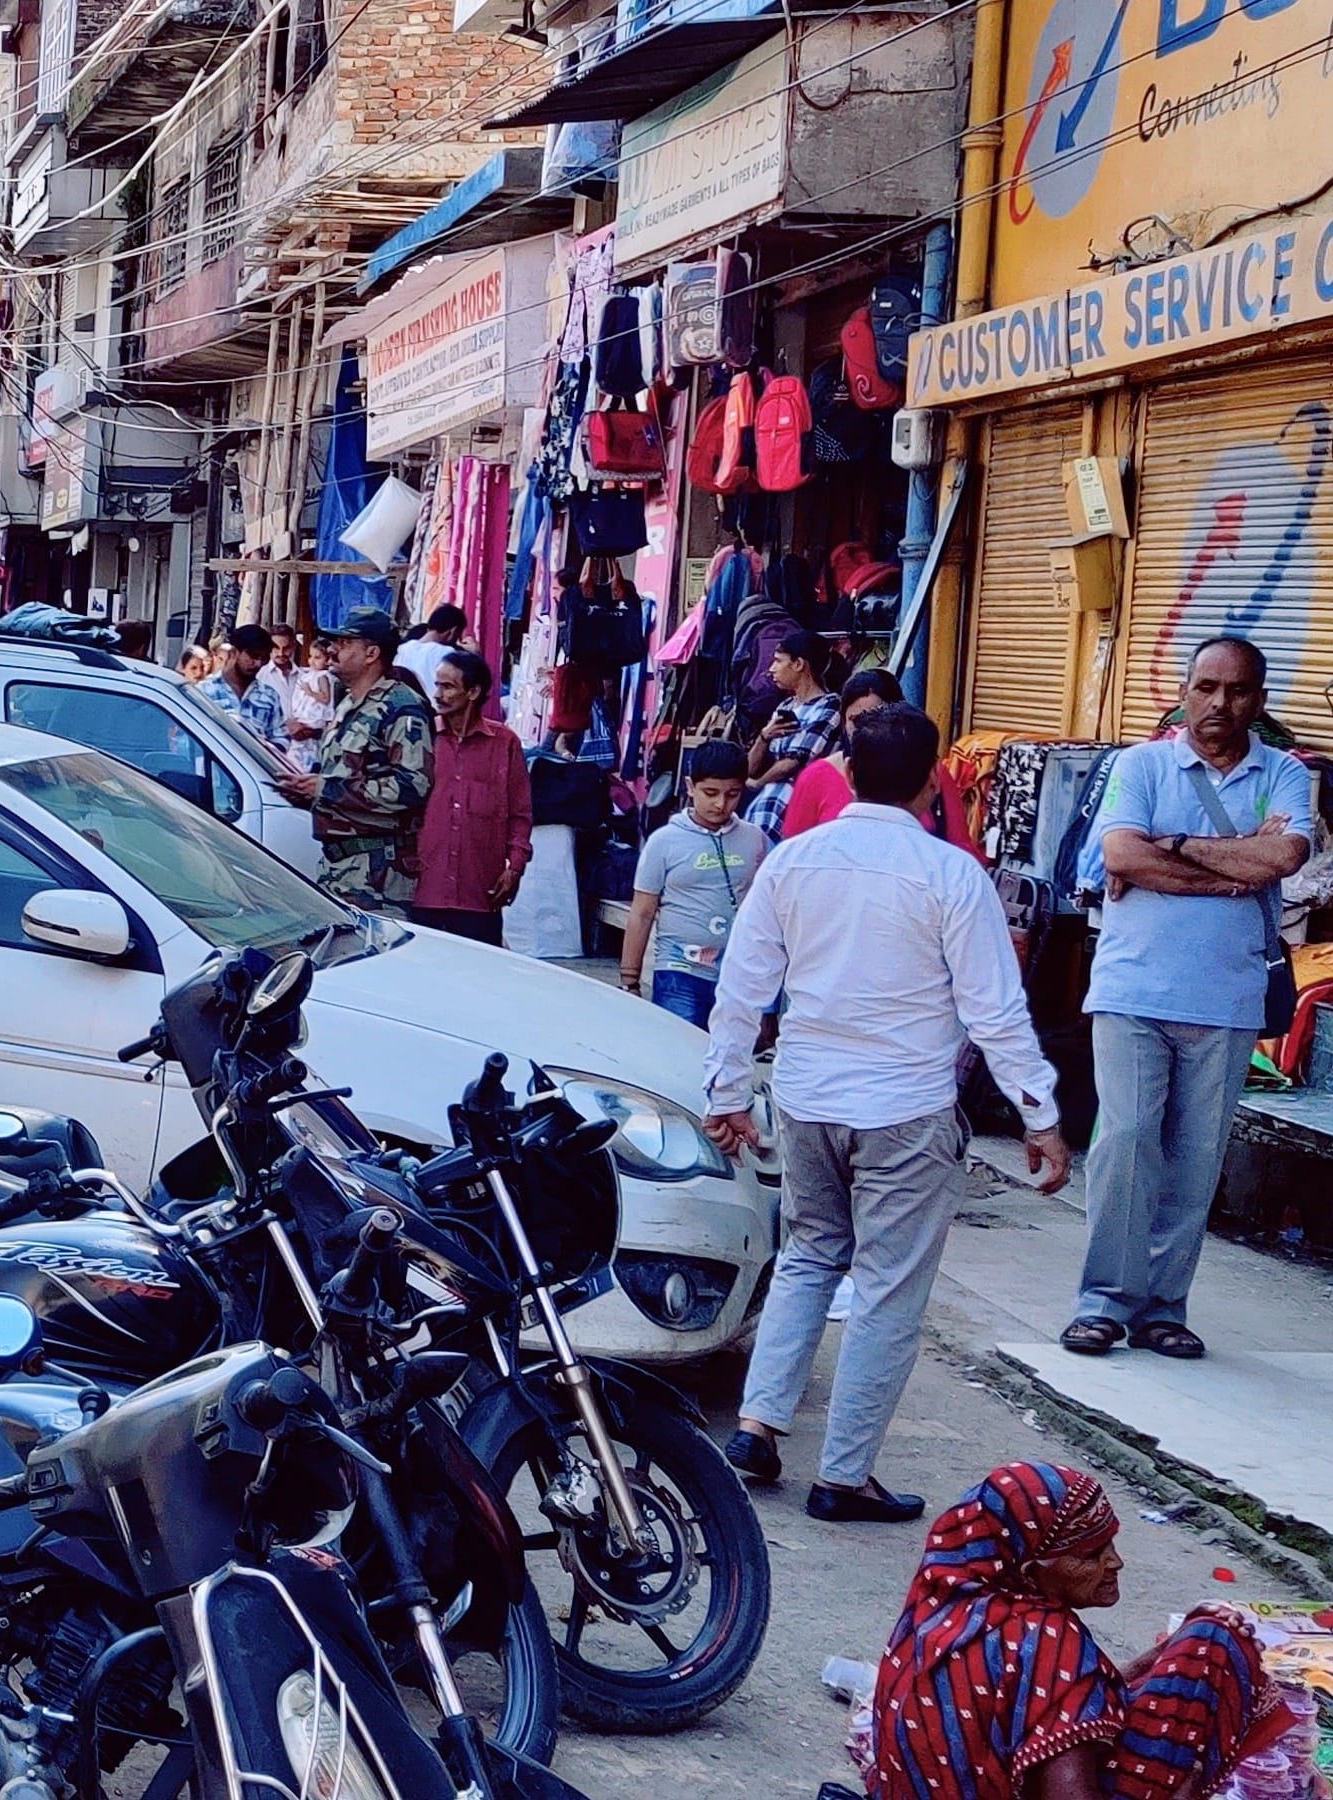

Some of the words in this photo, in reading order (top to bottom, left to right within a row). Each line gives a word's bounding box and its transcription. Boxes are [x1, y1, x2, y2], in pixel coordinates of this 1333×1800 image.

[460, 271, 502, 328] HOUSE
[939, 289, 1106, 392] CUSTOMER
[1123, 232, 1296, 350] SERVICE
